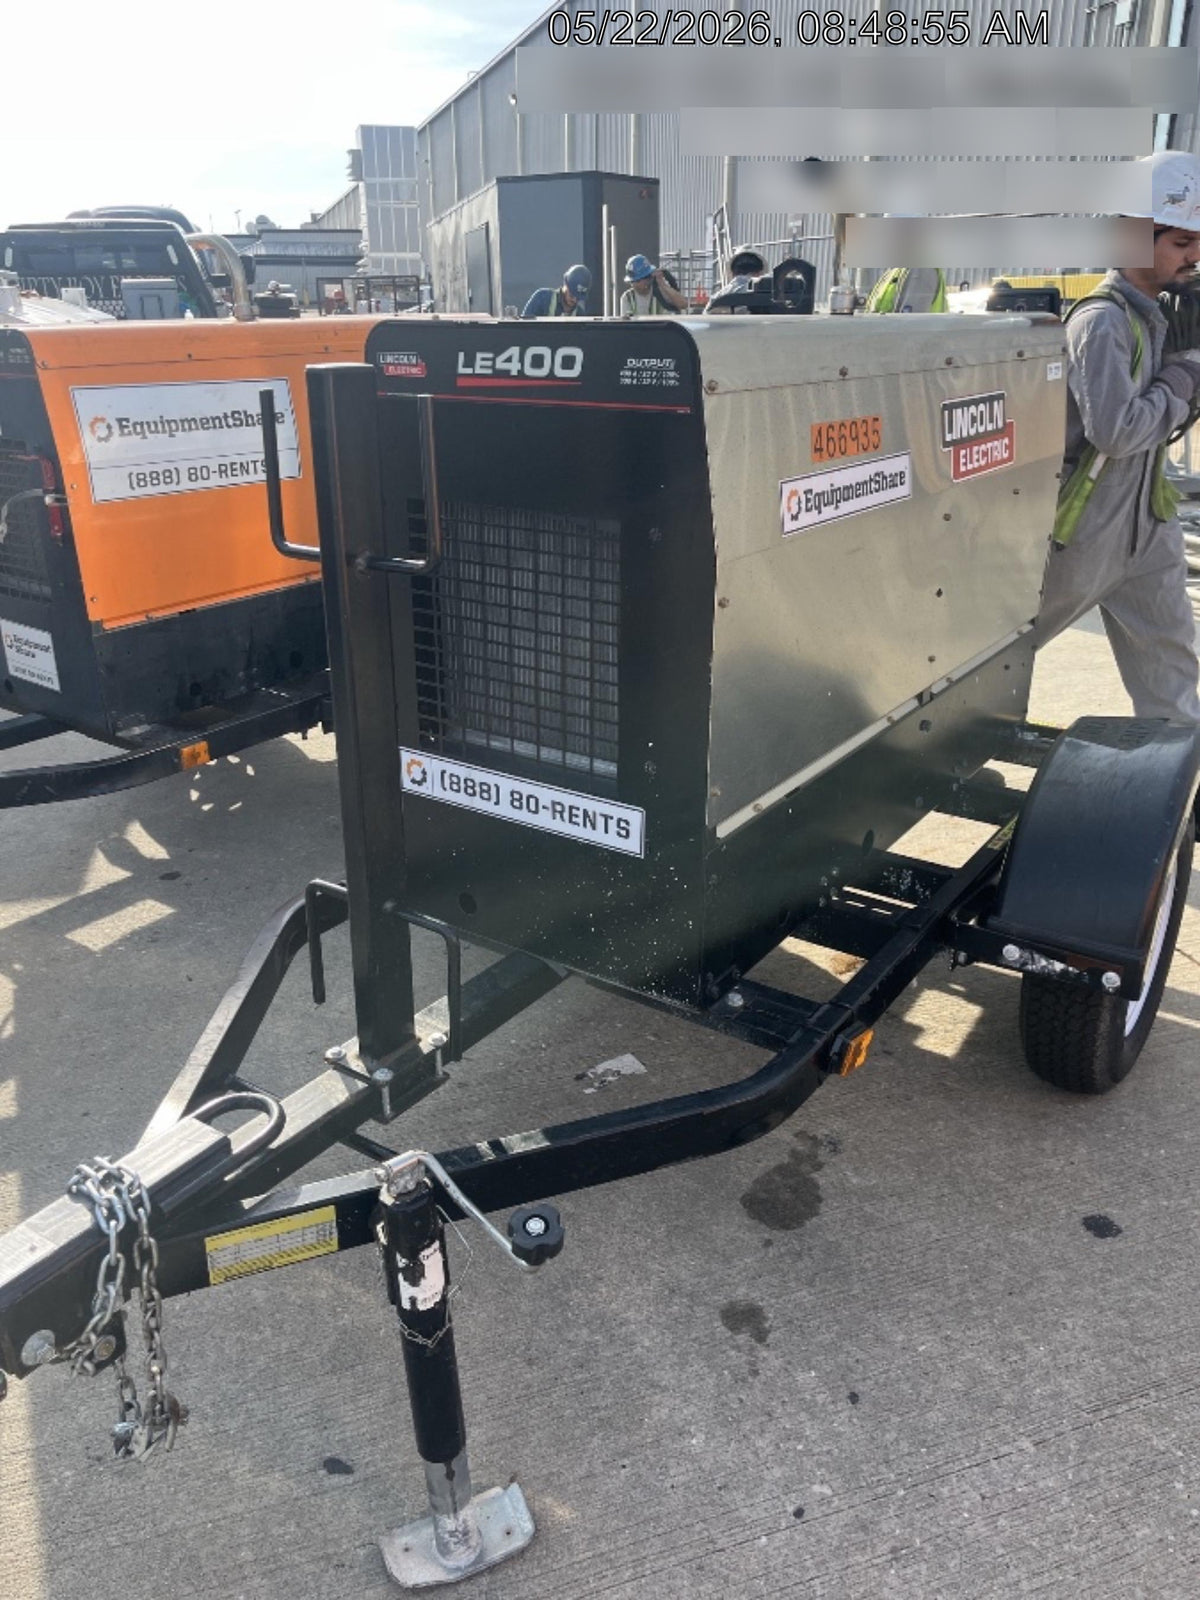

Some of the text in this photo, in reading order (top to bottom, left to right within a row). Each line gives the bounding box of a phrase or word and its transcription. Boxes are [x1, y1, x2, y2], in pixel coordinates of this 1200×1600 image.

[379, 353, 417, 365] LINCOLN
[457, 345, 584, 378] LE400
[115, 409, 286, 440] EquipmentShae
[813, 417, 881, 458] 466935
[943, 399, 1004, 442] LINCOLN
[959, 437, 1009, 472] ELECTRIC
[127, 467, 181, 491] (888)
[803, 470, 906, 515] EquipmentShare
[439, 769, 631, 840] (888) 80-RENTS
